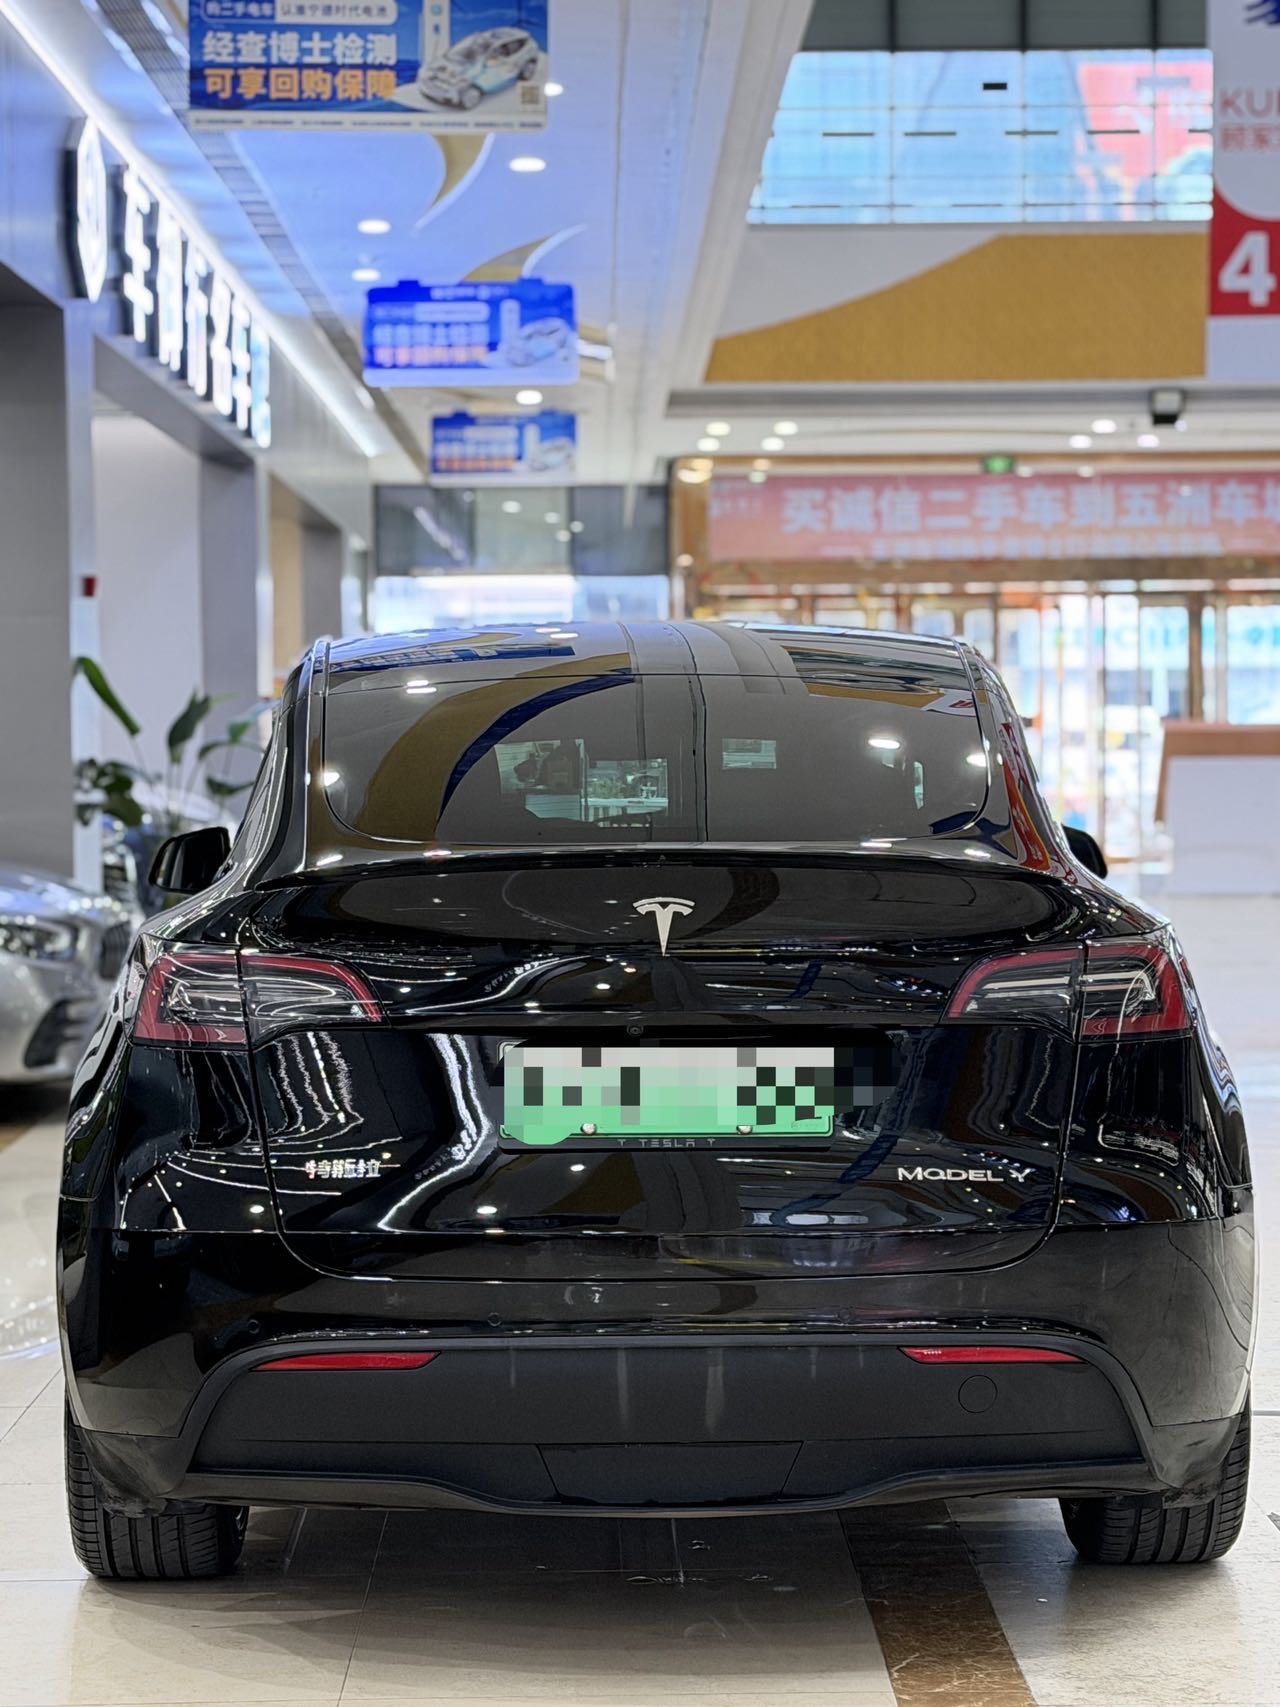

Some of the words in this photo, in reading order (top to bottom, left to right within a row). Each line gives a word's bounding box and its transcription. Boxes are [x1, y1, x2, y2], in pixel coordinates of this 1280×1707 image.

[203, 30, 398, 66] 经查博士检测
[203, 67, 398, 101] 可享回购保障
[639, 1139, 695, 1149] TESLA
[897, 1167, 1004, 1183] MODEL
[1009, 1168, 1034, 1183] Y
